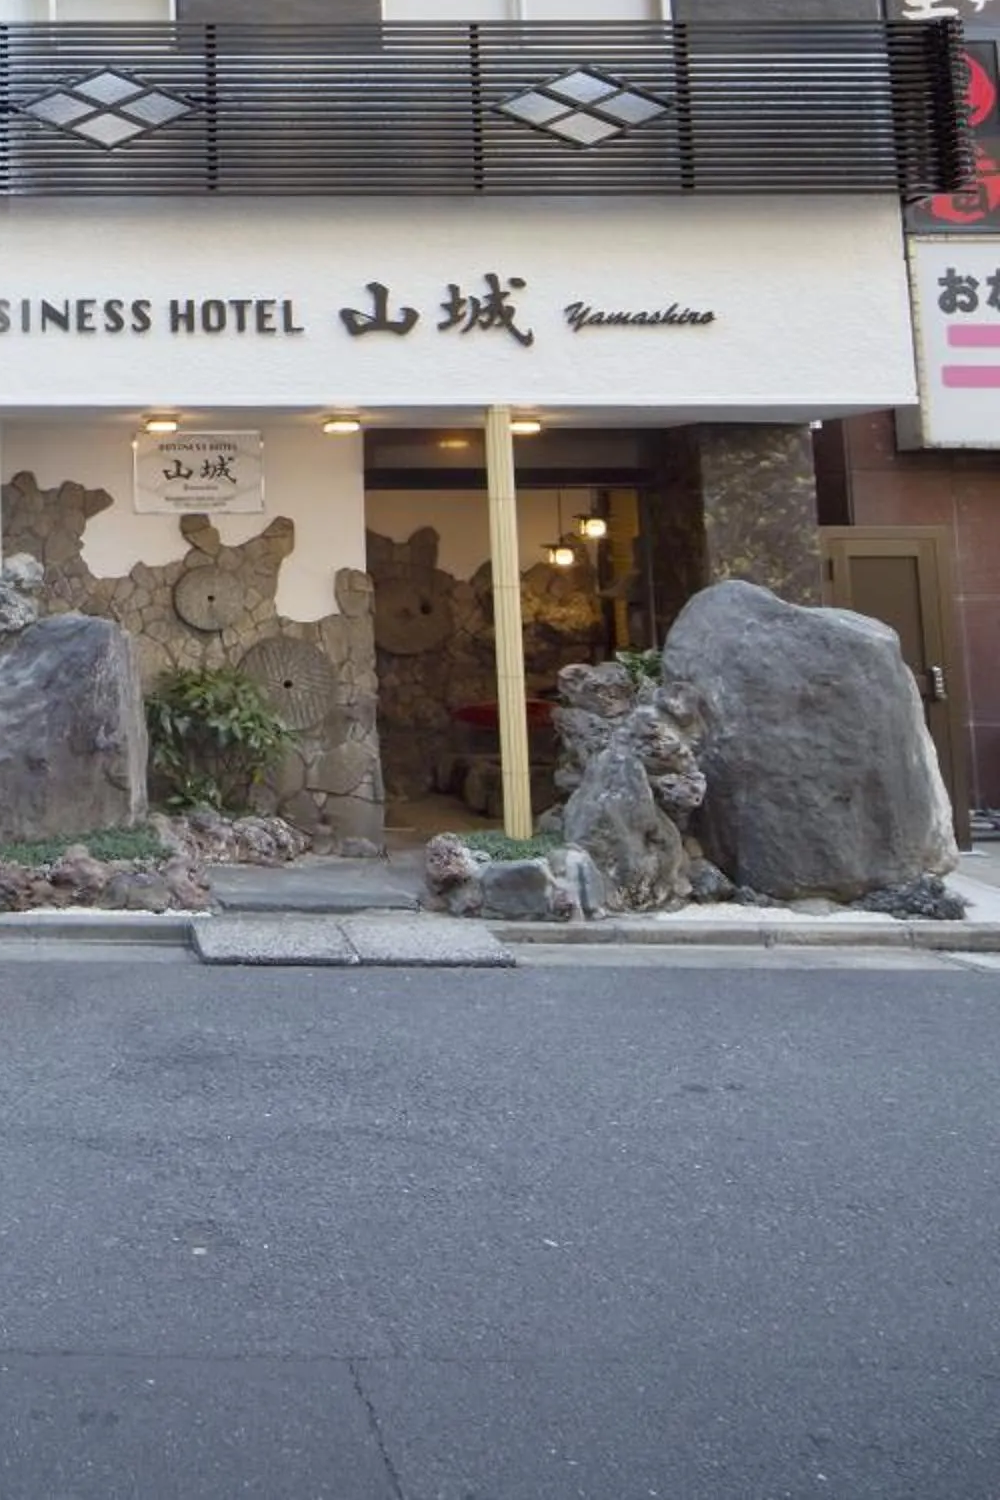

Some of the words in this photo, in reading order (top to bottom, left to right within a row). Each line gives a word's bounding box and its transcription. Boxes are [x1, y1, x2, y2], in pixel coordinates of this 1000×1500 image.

[170, 298, 305, 334] HOTEL
[339, 272, 535, 348] 山城
[564, 300, 718, 333] Yamashiro
[162, 455, 237, 484] 山城
